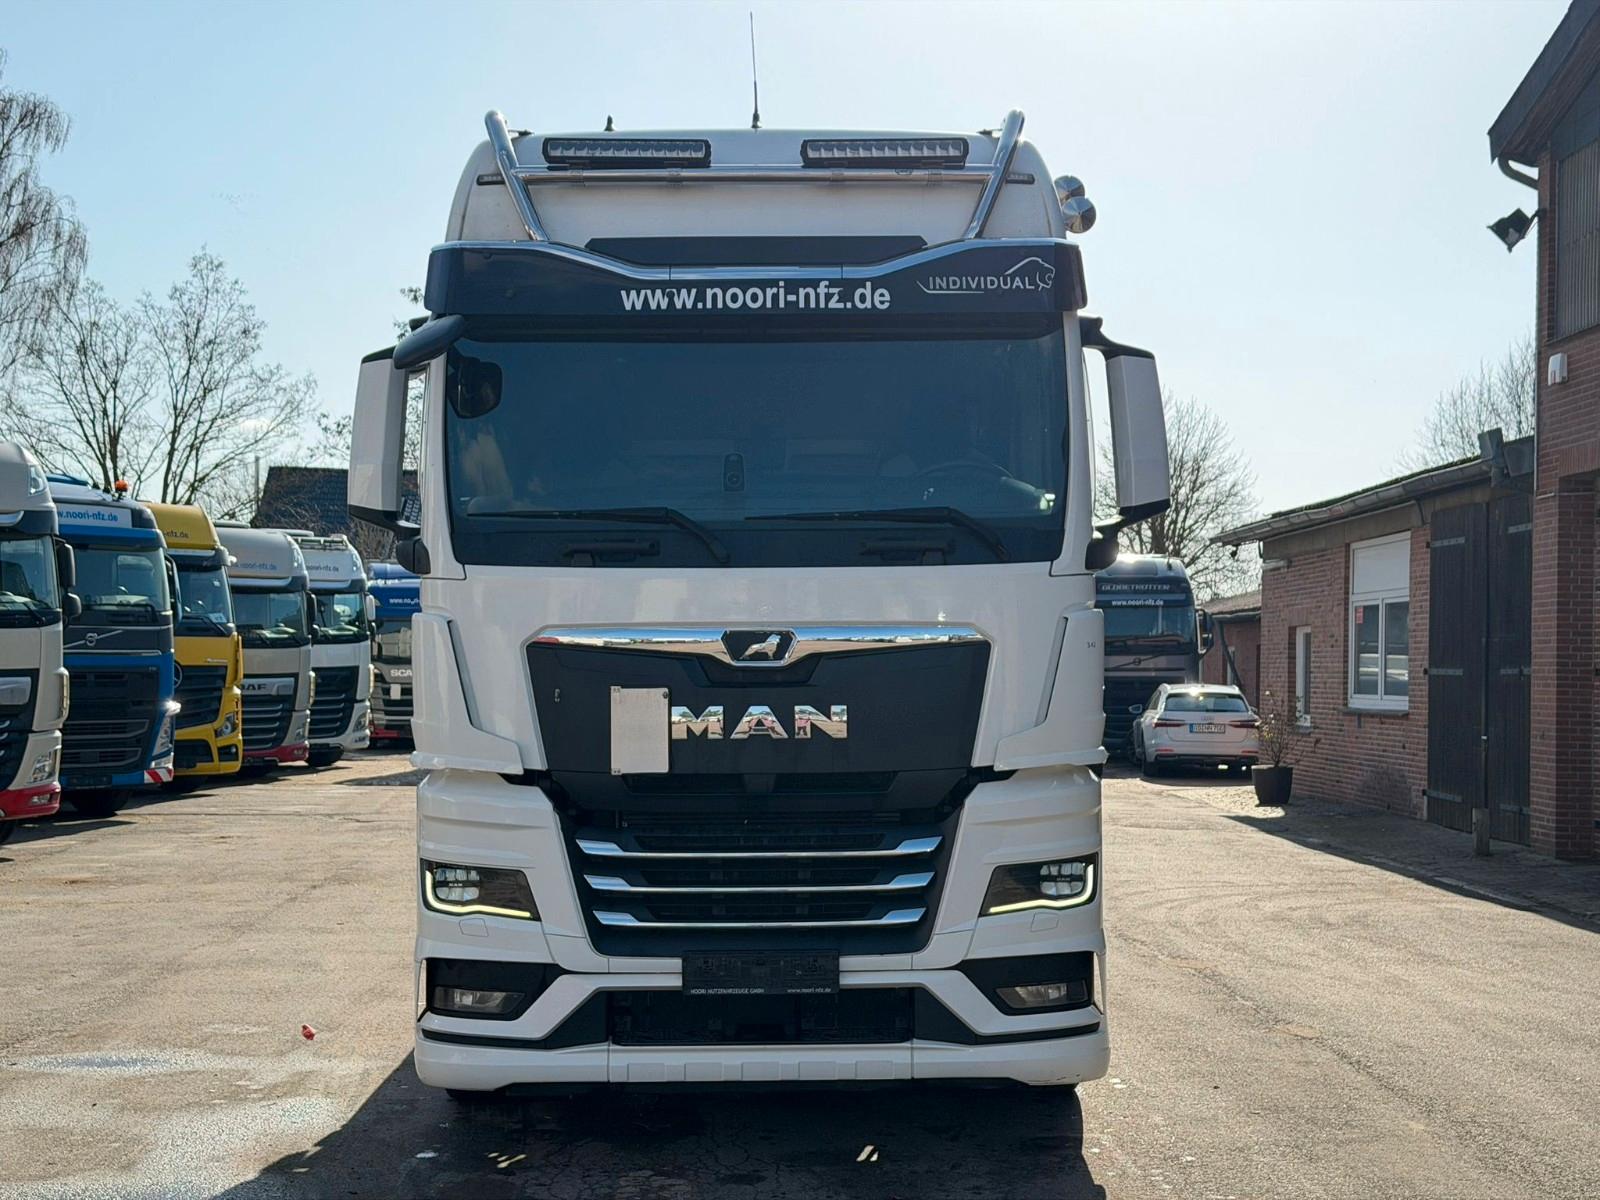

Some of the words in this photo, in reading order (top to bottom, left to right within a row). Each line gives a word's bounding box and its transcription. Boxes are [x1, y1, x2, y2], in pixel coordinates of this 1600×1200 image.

[929, 276, 1035, 290] INDIVIDUAL
[620, 281, 891, 311] www.noori-nfz.de
[1101, 583, 1170, 591] GLOBETROTTER
[1111, 598, 1164, 606] www.noori-nfz.de
[671, 704, 848, 740] MAN
